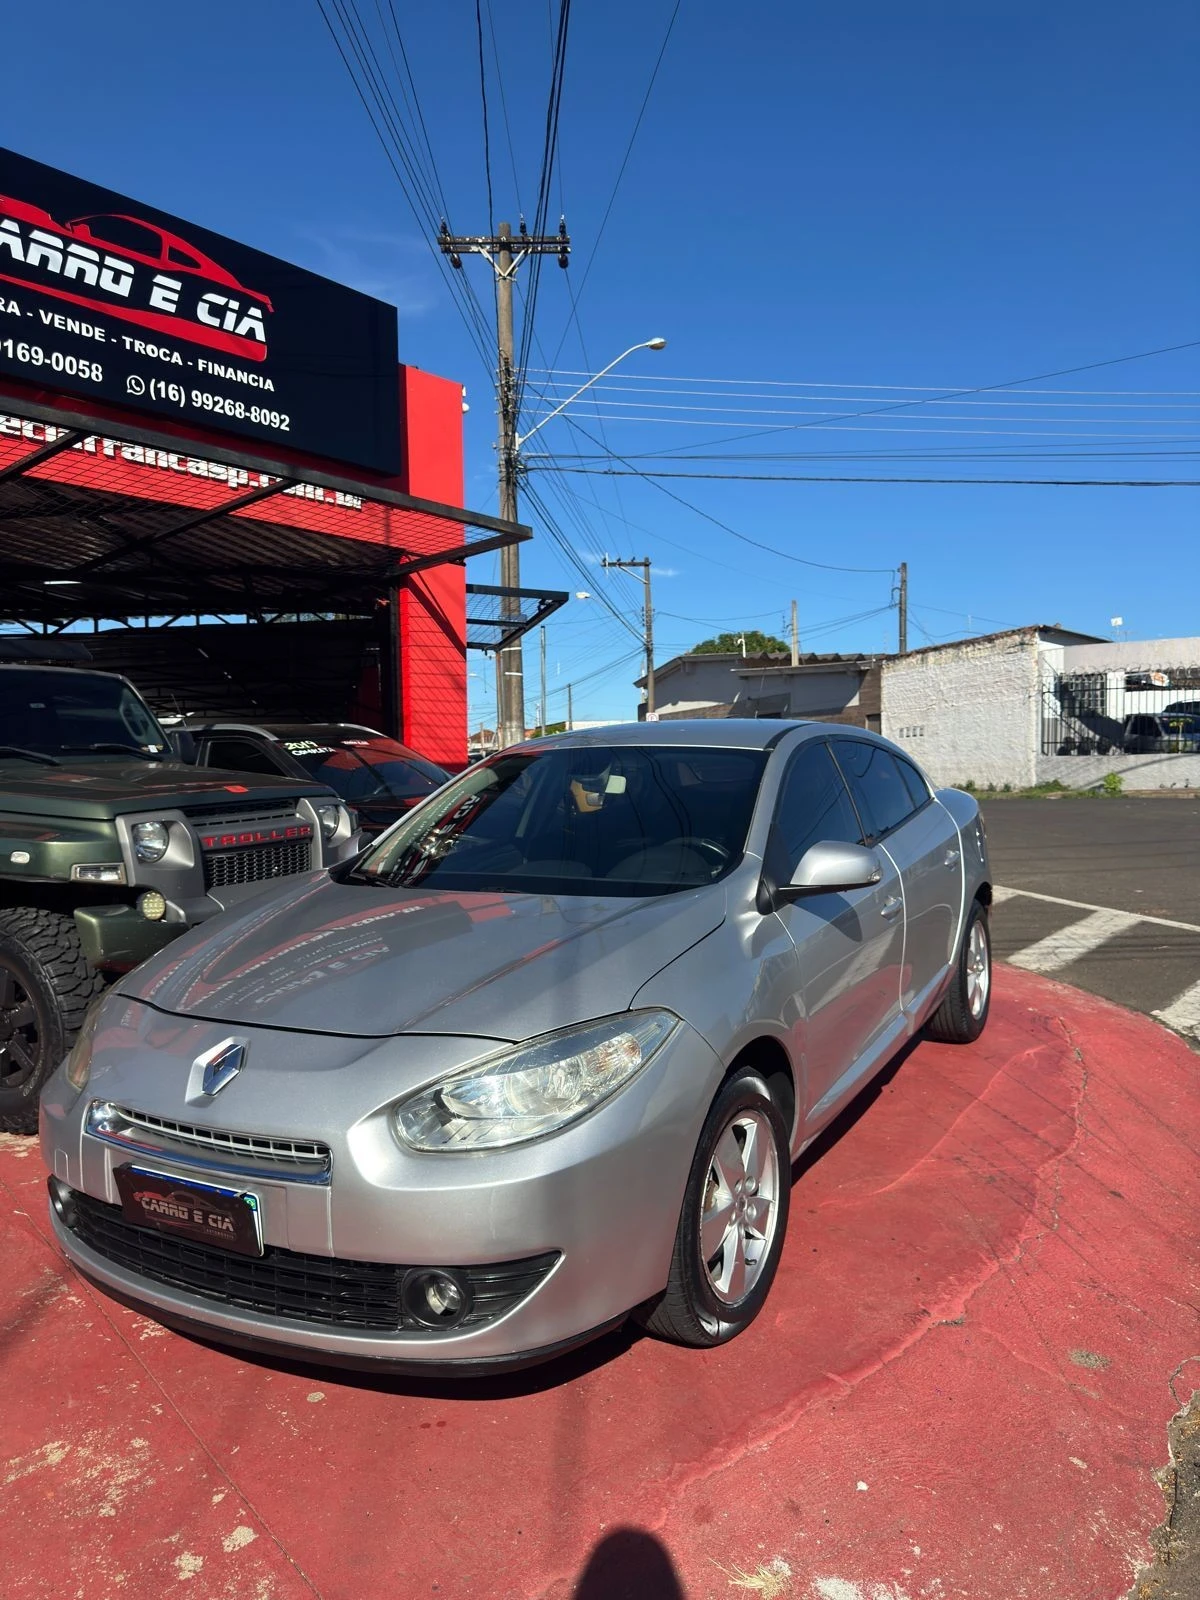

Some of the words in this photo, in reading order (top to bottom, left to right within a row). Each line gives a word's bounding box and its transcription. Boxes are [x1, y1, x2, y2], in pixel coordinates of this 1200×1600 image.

[149, 273, 183, 313] E
[196, 292, 266, 343] CIA
[39, 309, 106, 342] VENDE
[121, 335, 183, 366] TROCA
[198, 358, 275, 392] FINANCIA
[0, 338, 103, 382] 169-0058
[149, 378, 186, 408] (16)
[191, 389, 290, 431] 99268-8092
[285, 740, 318, 750] 2019
[201, 825, 311, 848] TROLLER
[141, 1197, 189, 1220] CARRO
[193, 1209, 203, 1224] E
[208, 1213, 234, 1232] CIA
